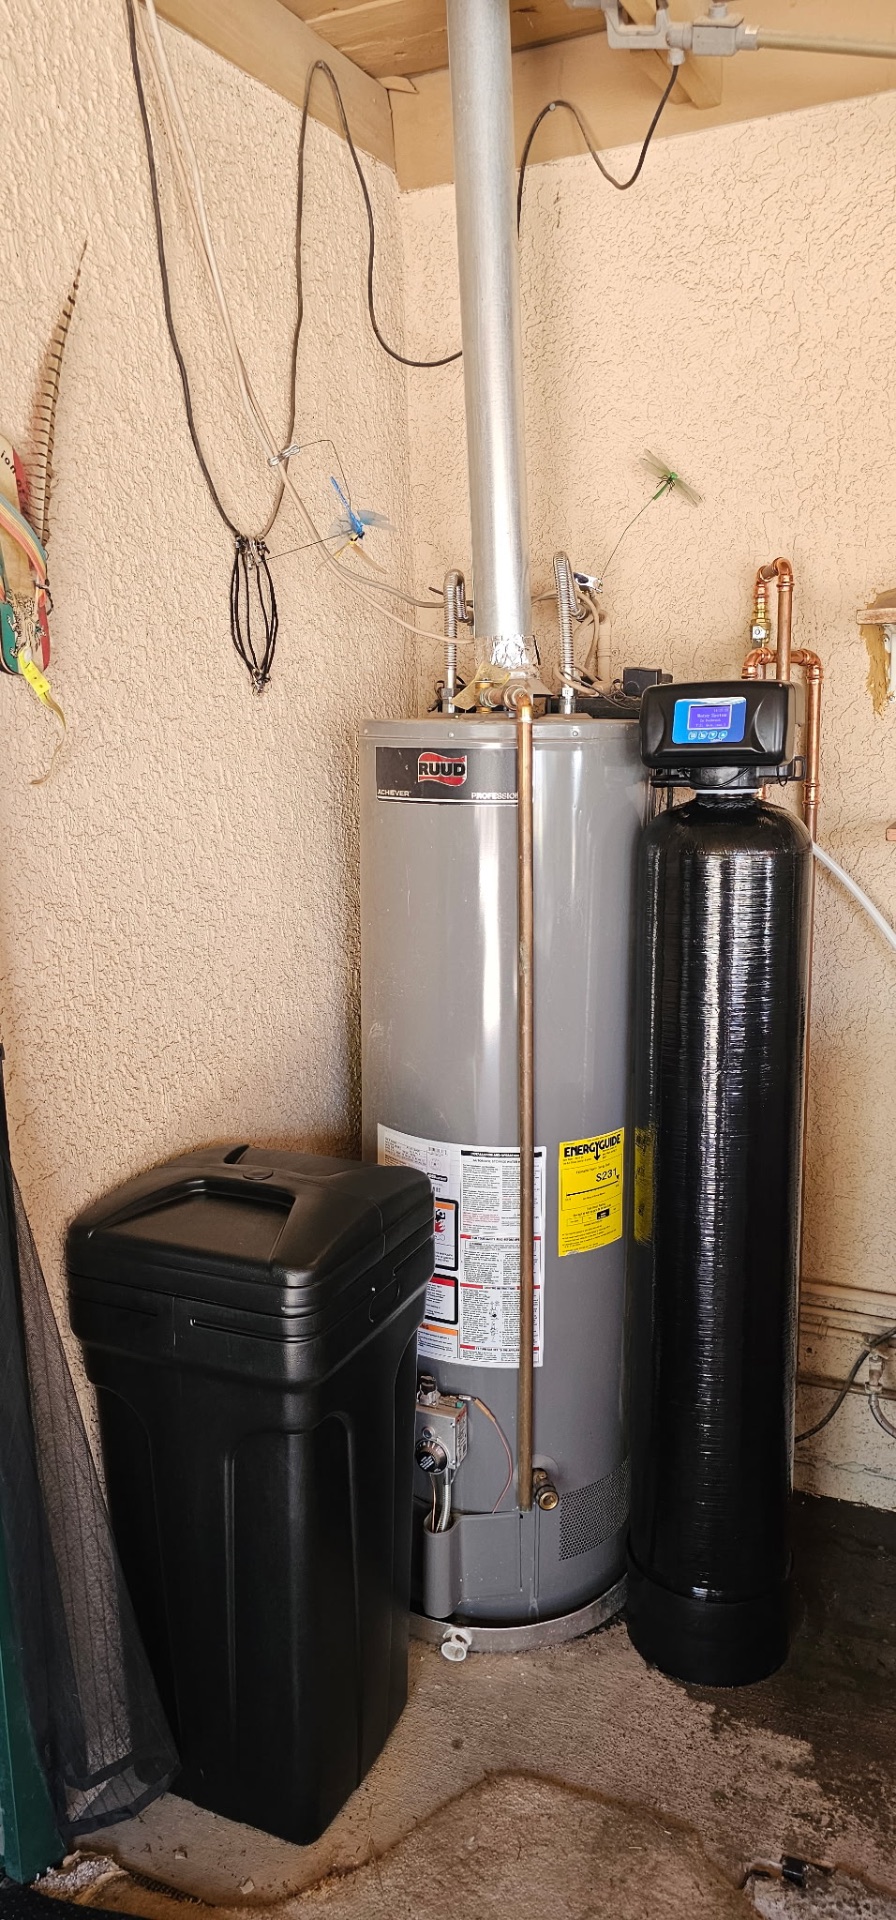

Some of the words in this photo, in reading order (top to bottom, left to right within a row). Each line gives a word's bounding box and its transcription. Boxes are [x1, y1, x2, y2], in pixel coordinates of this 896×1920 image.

[418, 762, 466, 776] RUUD
[377, 789, 411, 797] ACHIEVER
[471, 792, 518, 800] PROFESSIO
